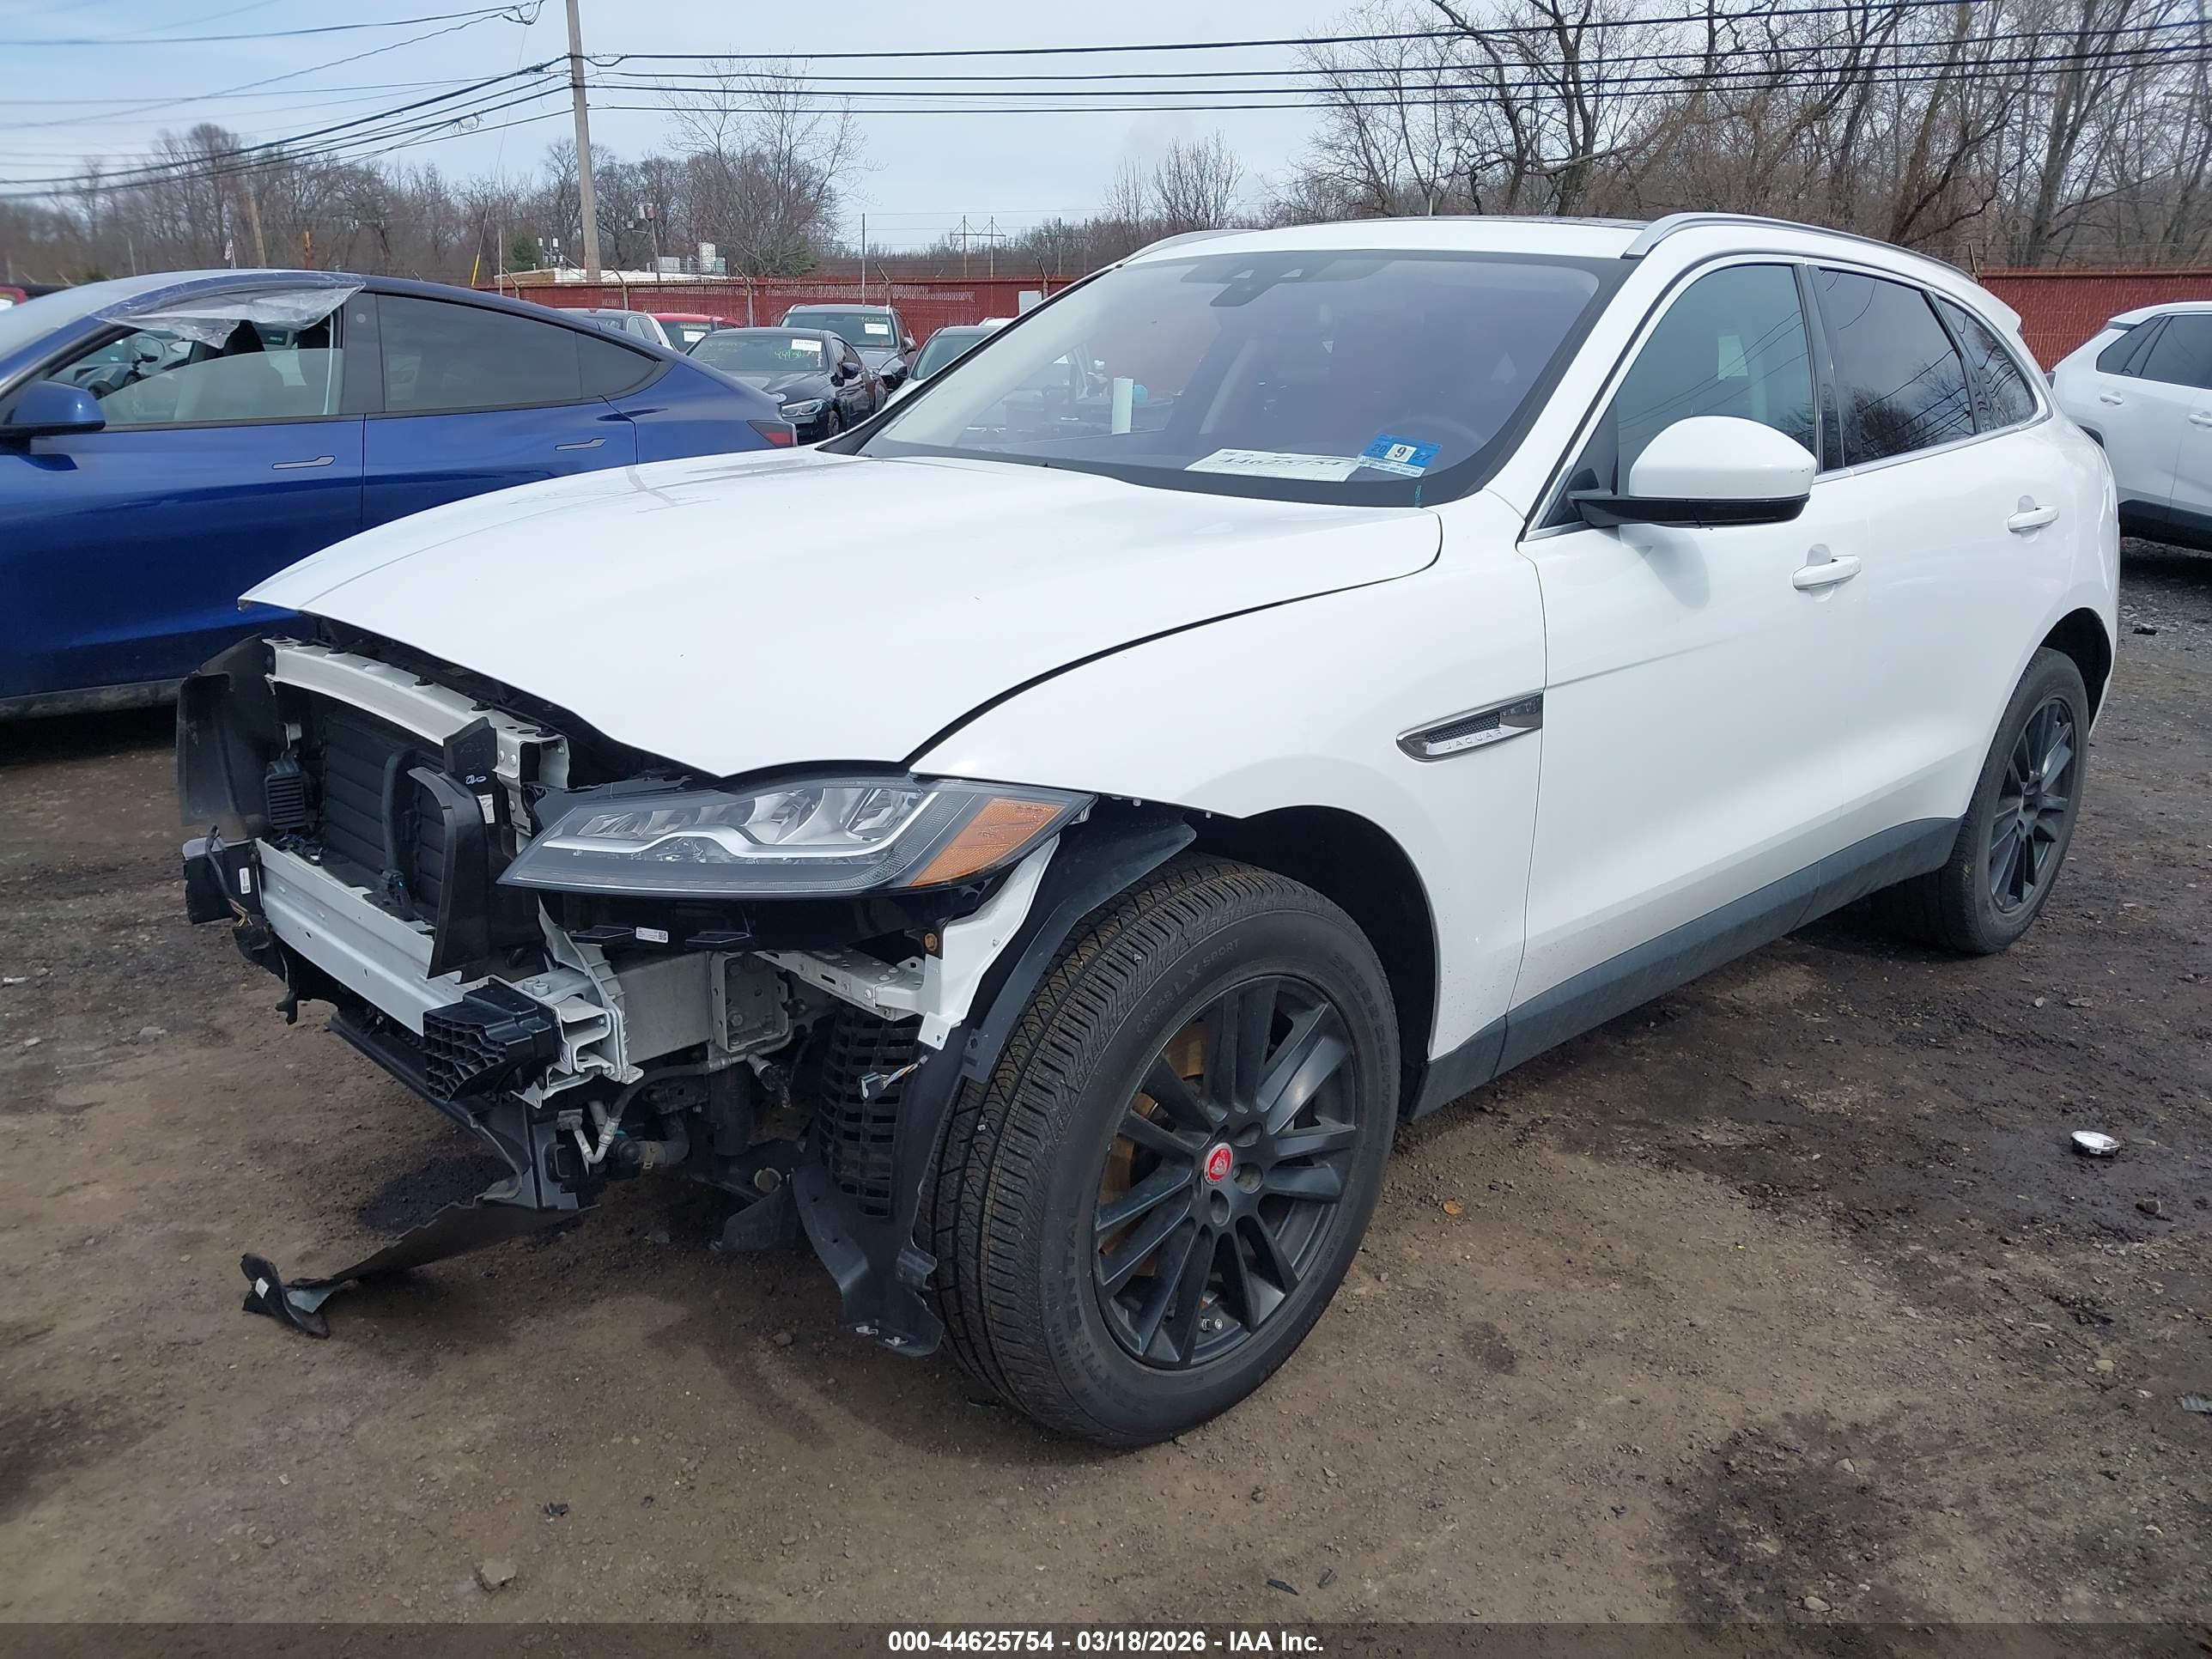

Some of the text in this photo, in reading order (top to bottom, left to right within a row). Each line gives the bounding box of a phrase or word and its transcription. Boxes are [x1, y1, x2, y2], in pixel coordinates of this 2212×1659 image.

[1371, 443, 1388, 453] 20
[1395, 446, 1407, 459] 9
[1445, 731, 1503, 750] JAGUAR
[1202, 939, 1241, 968] SPORT
